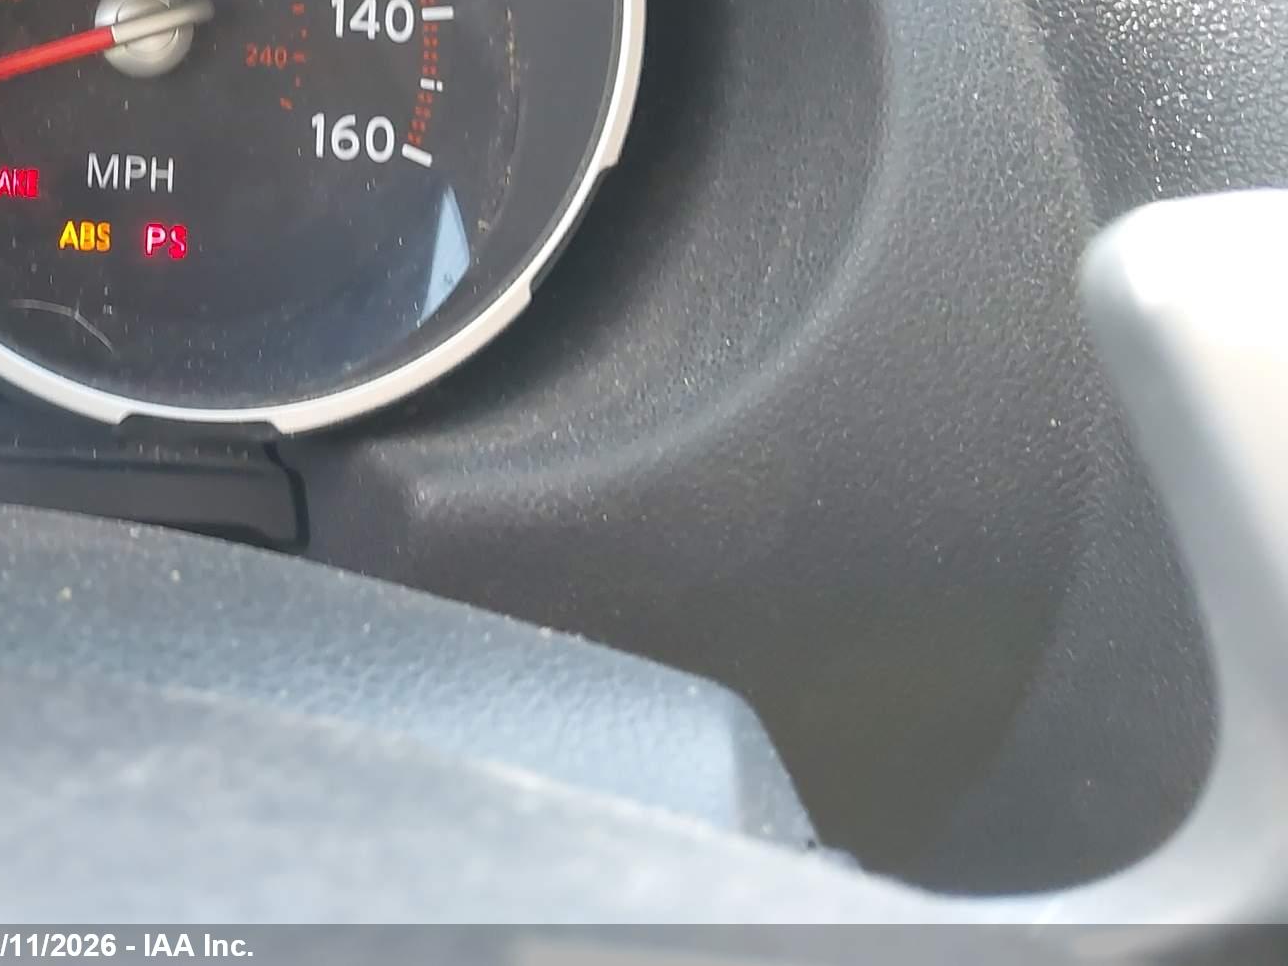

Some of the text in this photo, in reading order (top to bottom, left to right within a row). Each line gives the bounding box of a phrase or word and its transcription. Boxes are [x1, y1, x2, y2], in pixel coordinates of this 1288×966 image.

[245, 46, 288, 69] 240
[311, 113, 396, 164] 160
[87, 151, 175, 194] MPH
[58, 220, 111, 252] ABS
[145, 223, 188, 259] PS
